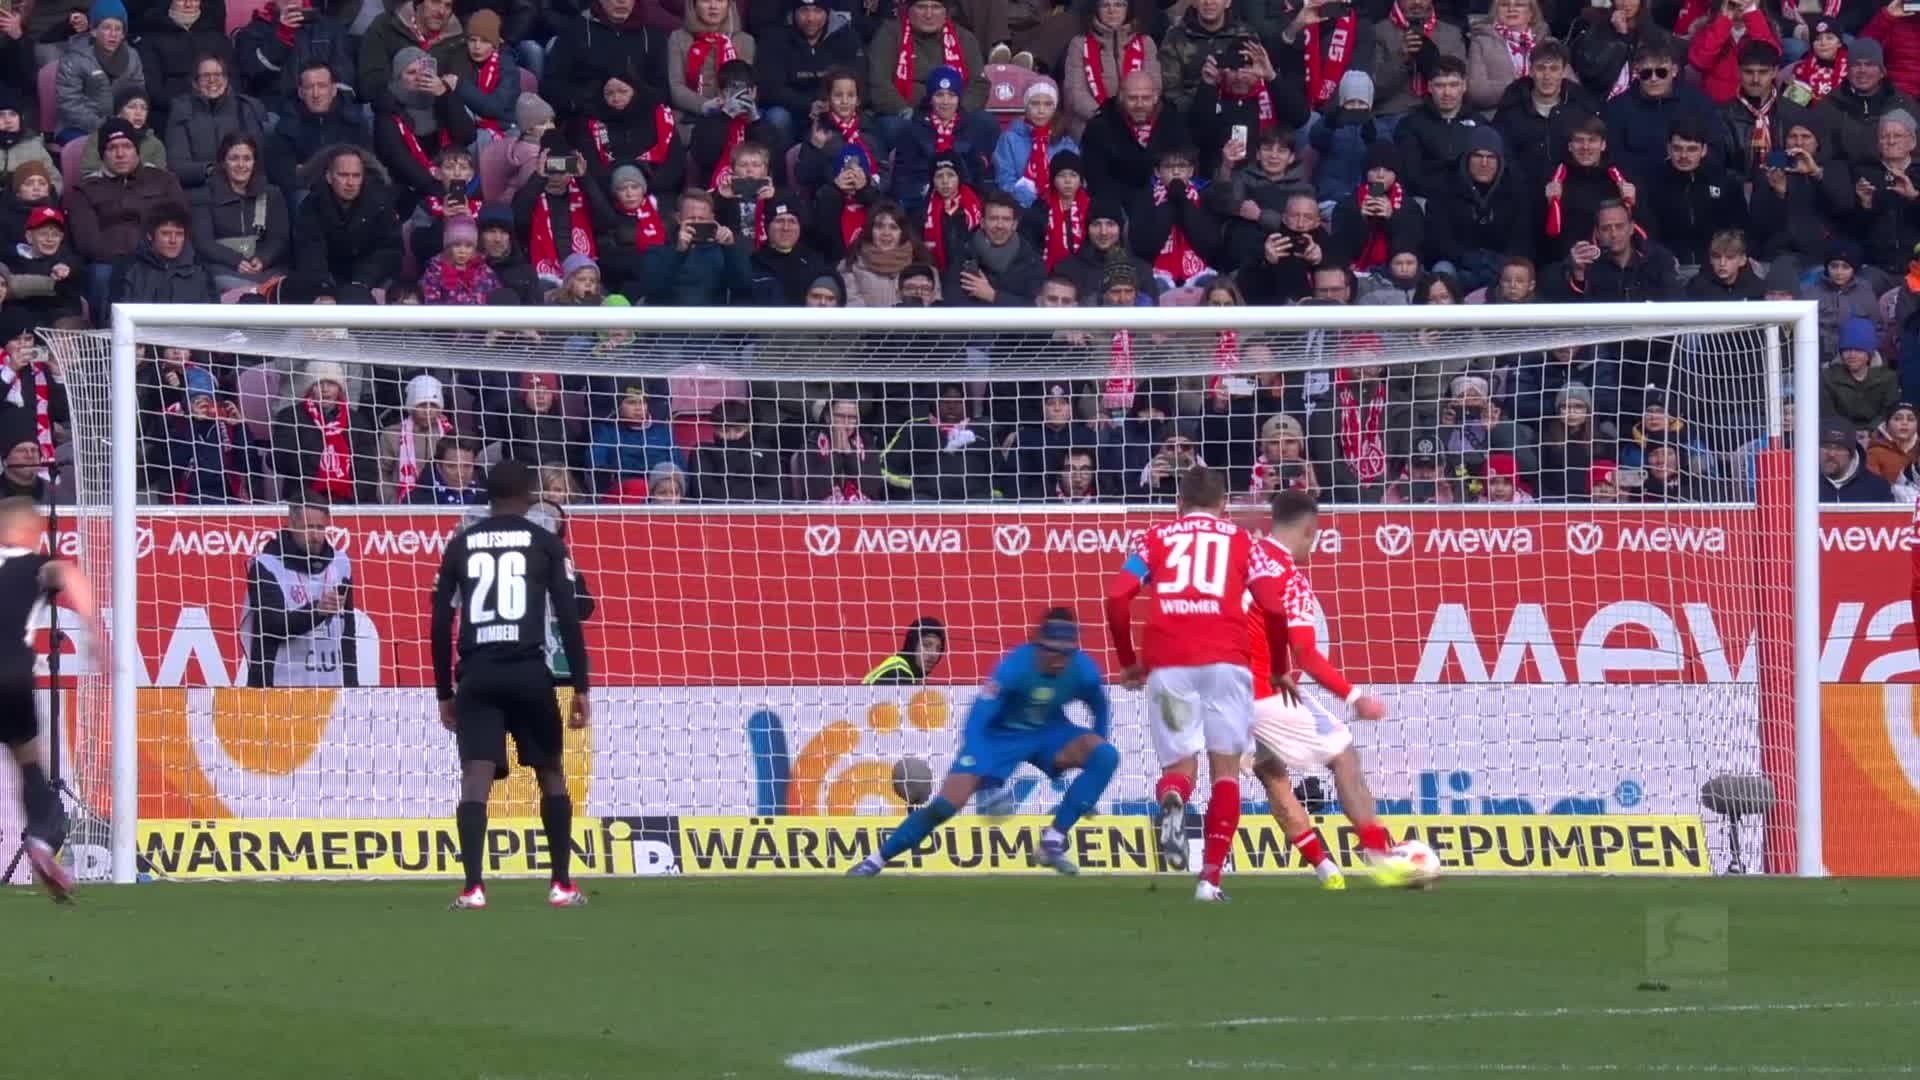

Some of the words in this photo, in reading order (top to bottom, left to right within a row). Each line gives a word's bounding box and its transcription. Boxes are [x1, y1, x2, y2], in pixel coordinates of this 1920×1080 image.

[467, 551, 527, 624] 26
[1157, 531, 1230, 597] 30
[1160, 599, 1221, 615] WIDMER
